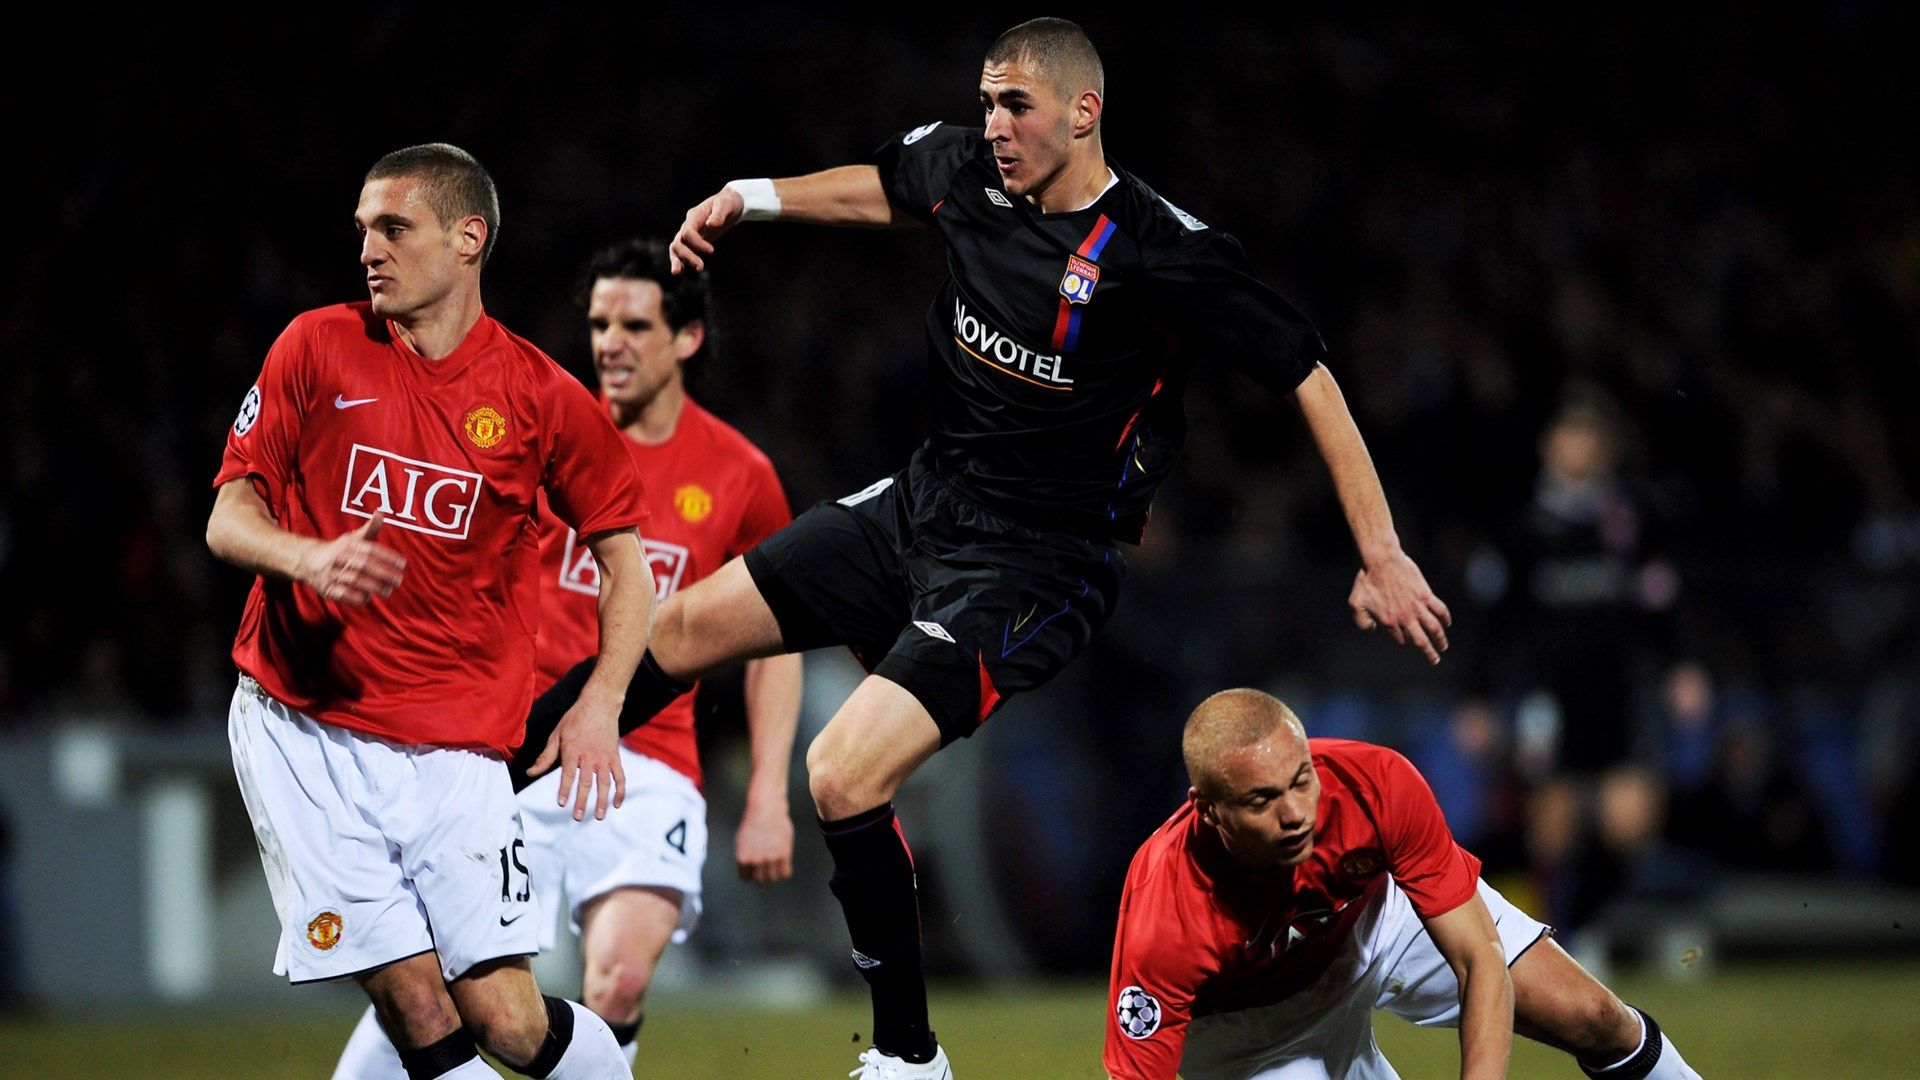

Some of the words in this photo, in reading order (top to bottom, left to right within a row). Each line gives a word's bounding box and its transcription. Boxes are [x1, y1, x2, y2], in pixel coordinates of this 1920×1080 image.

[1063, 274, 1090, 301] OL
[954, 296, 1074, 383] NOVOTEL
[351, 458, 468, 530] AIG
[665, 819, 686, 855] 4
[499, 838, 530, 902] 15
